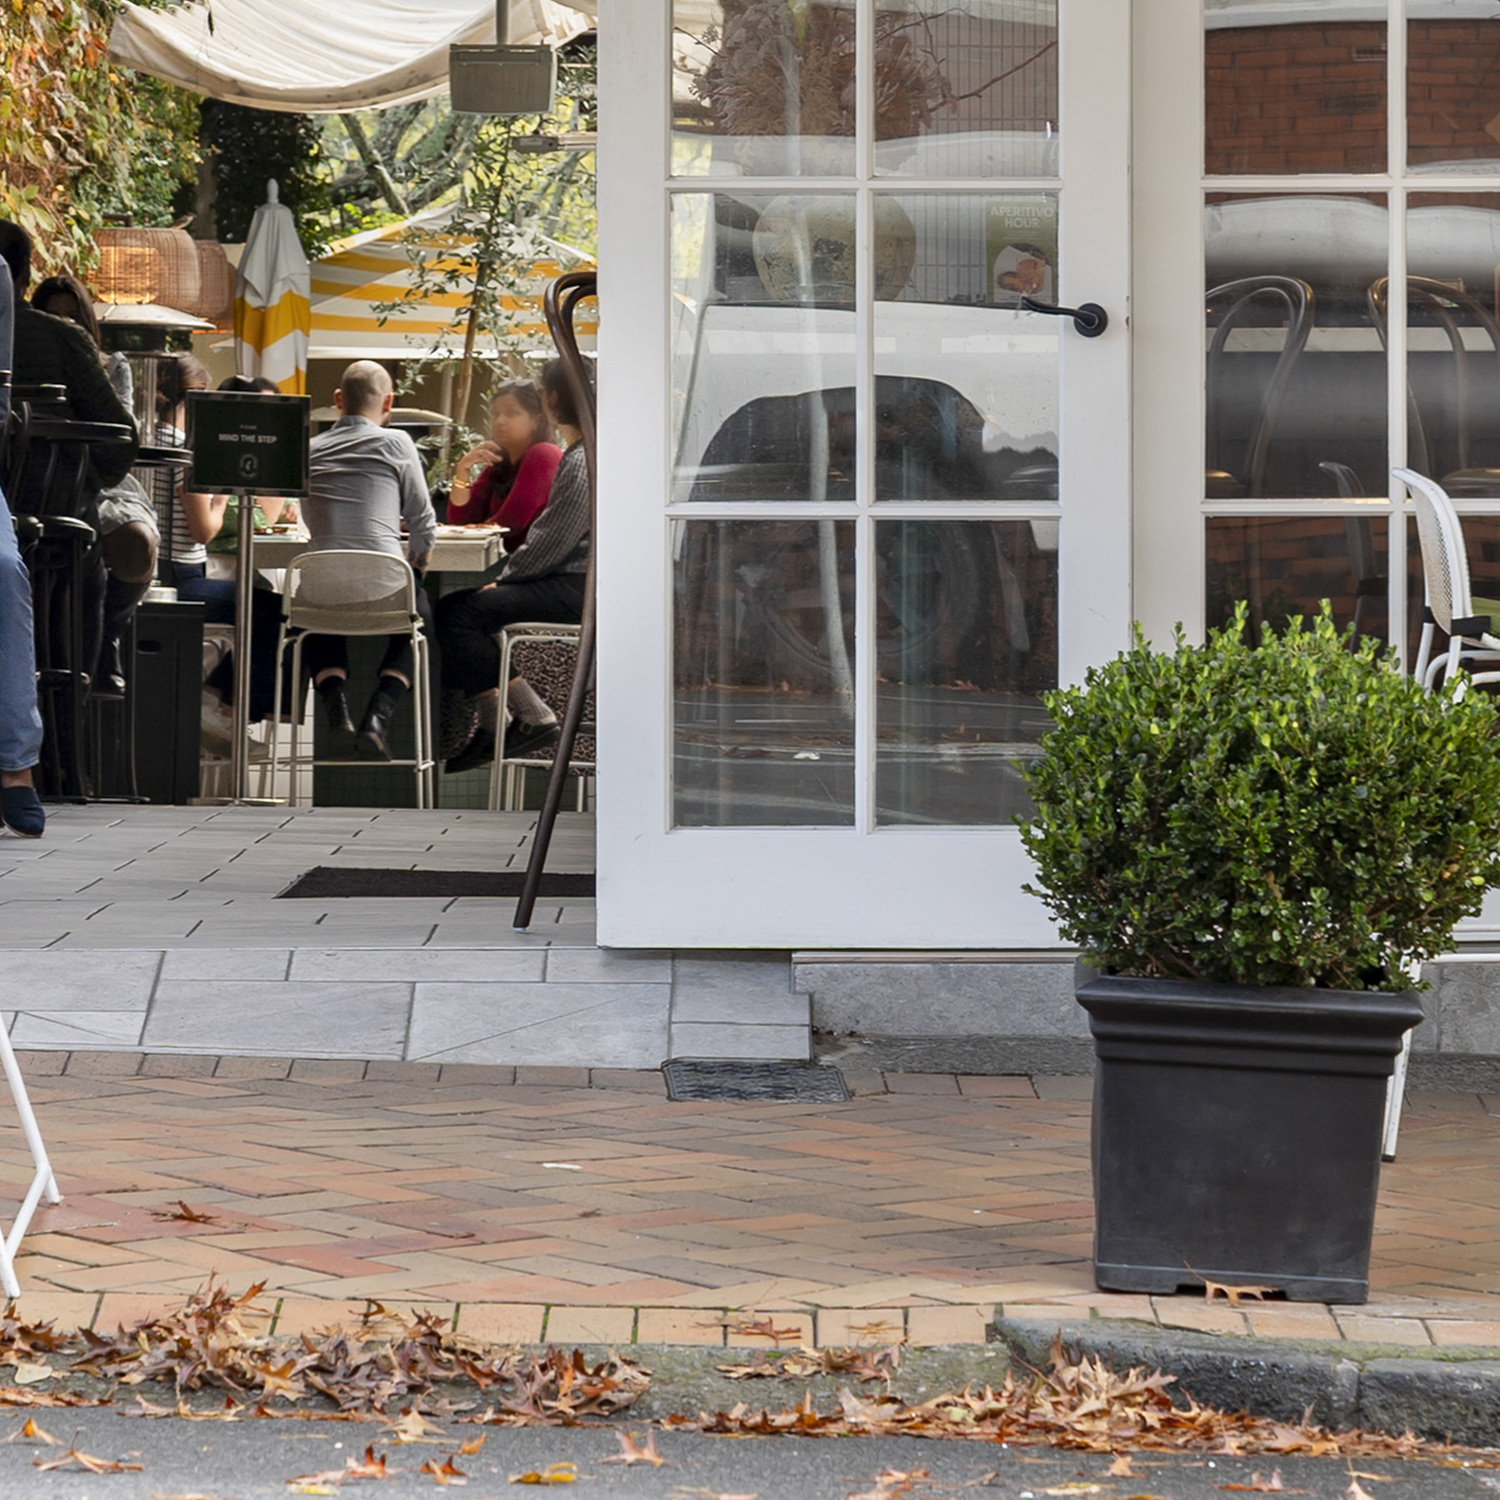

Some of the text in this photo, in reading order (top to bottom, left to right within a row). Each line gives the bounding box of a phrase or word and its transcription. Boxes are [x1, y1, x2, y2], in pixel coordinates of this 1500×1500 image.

[990, 206, 1054, 217] APERITIVO
[1005, 218, 1040, 228] HOUR
[241, 434, 256, 443] THE
